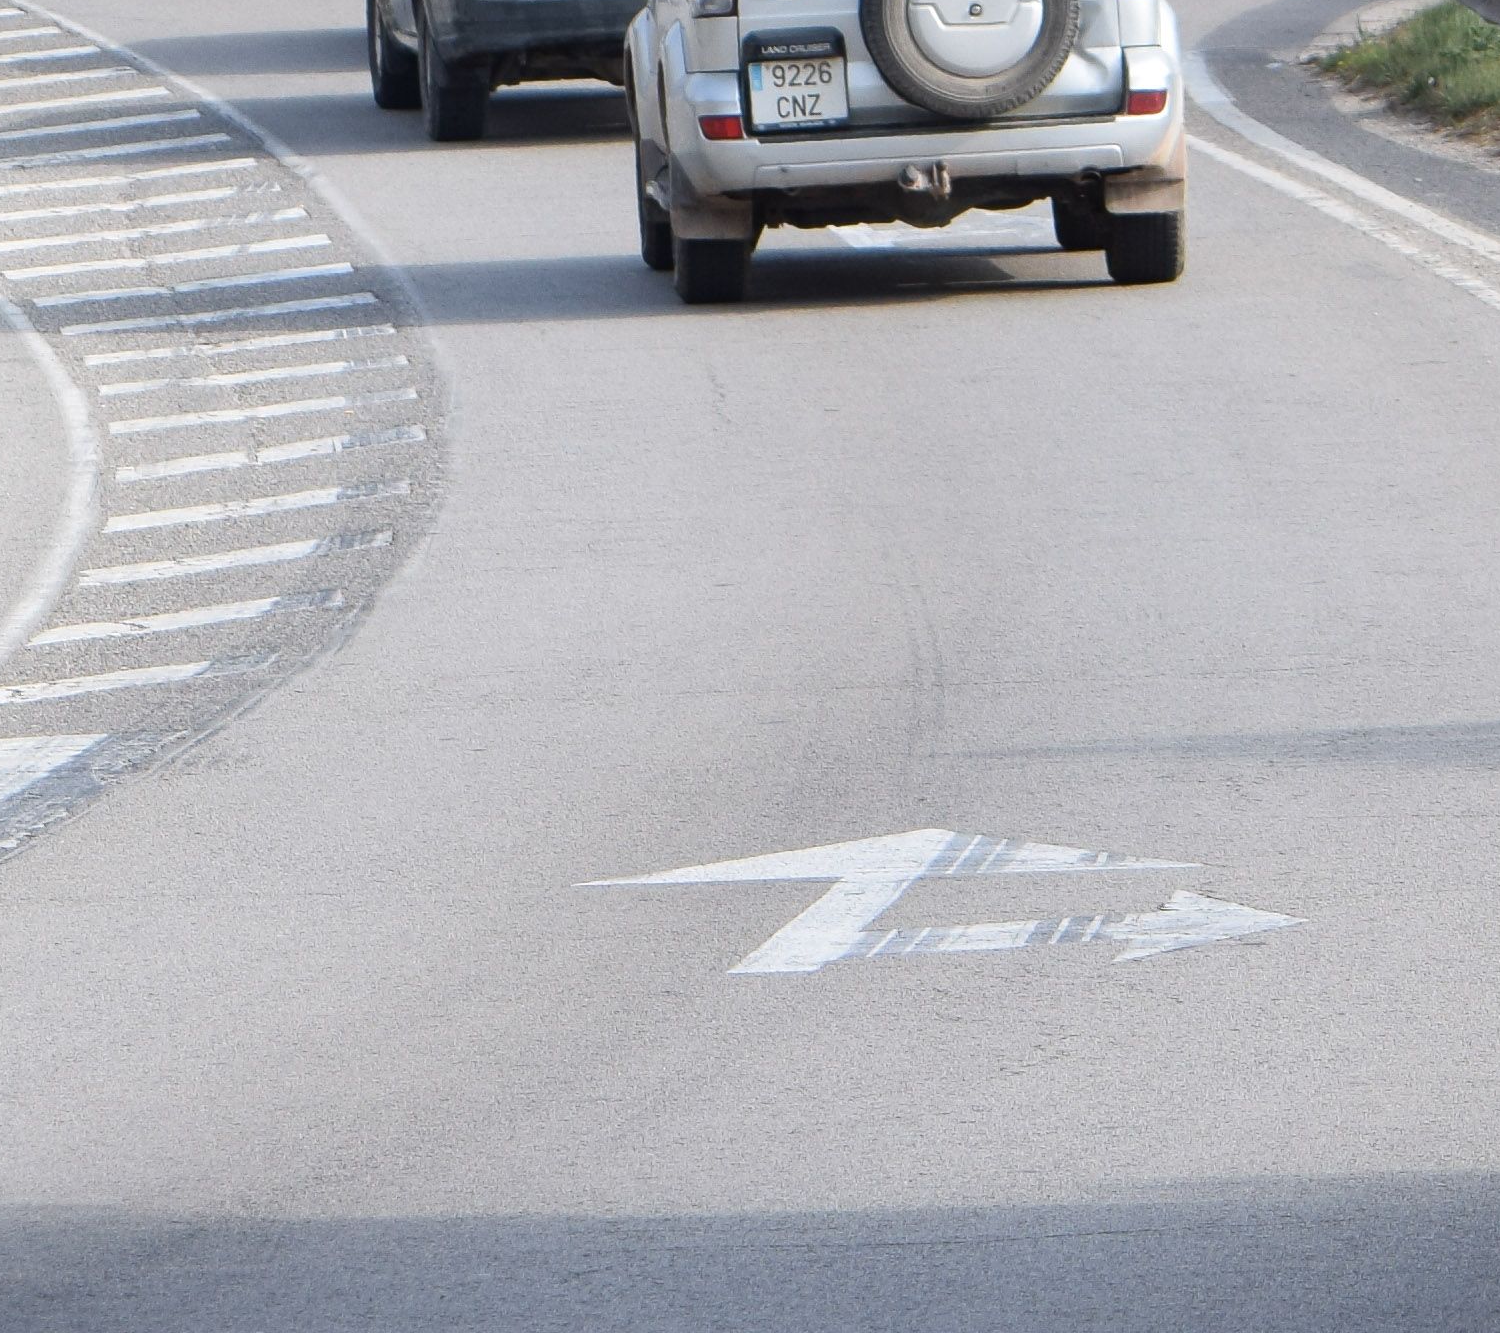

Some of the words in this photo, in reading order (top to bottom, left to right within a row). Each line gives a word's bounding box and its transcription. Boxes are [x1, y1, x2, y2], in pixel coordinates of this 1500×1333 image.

[761, 45, 787, 54] LAND
[789, 42, 831, 53] CRUISER
[772, 61, 832, 88] 9226
[777, 93, 822, 119] CNZ
